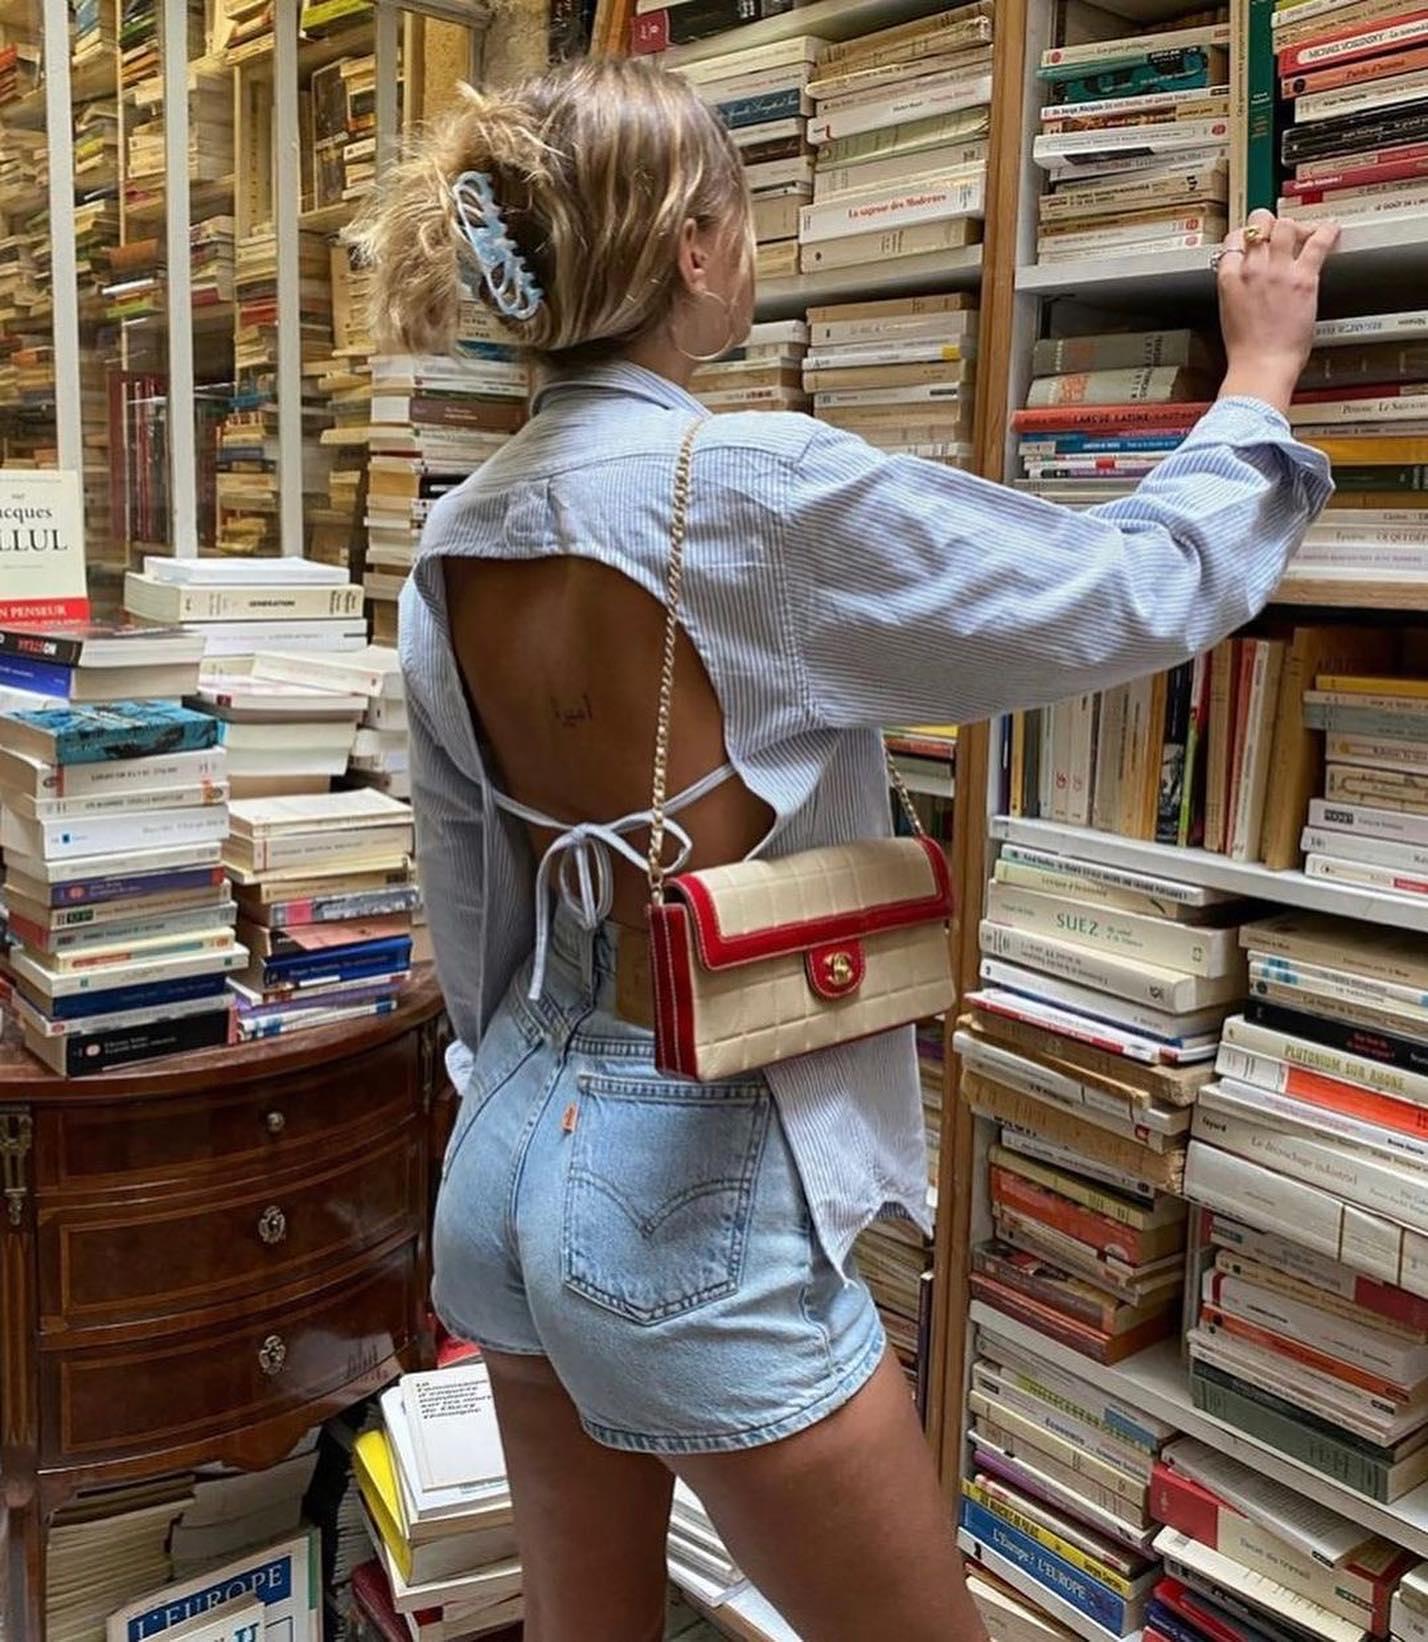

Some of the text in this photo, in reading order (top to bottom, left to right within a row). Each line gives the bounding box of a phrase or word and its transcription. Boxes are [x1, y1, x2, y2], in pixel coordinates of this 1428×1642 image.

[848, 208, 859, 218] La
[11, 605, 67, 618] PENSEUR
[1056, 912, 1098, 937] SUEZ
